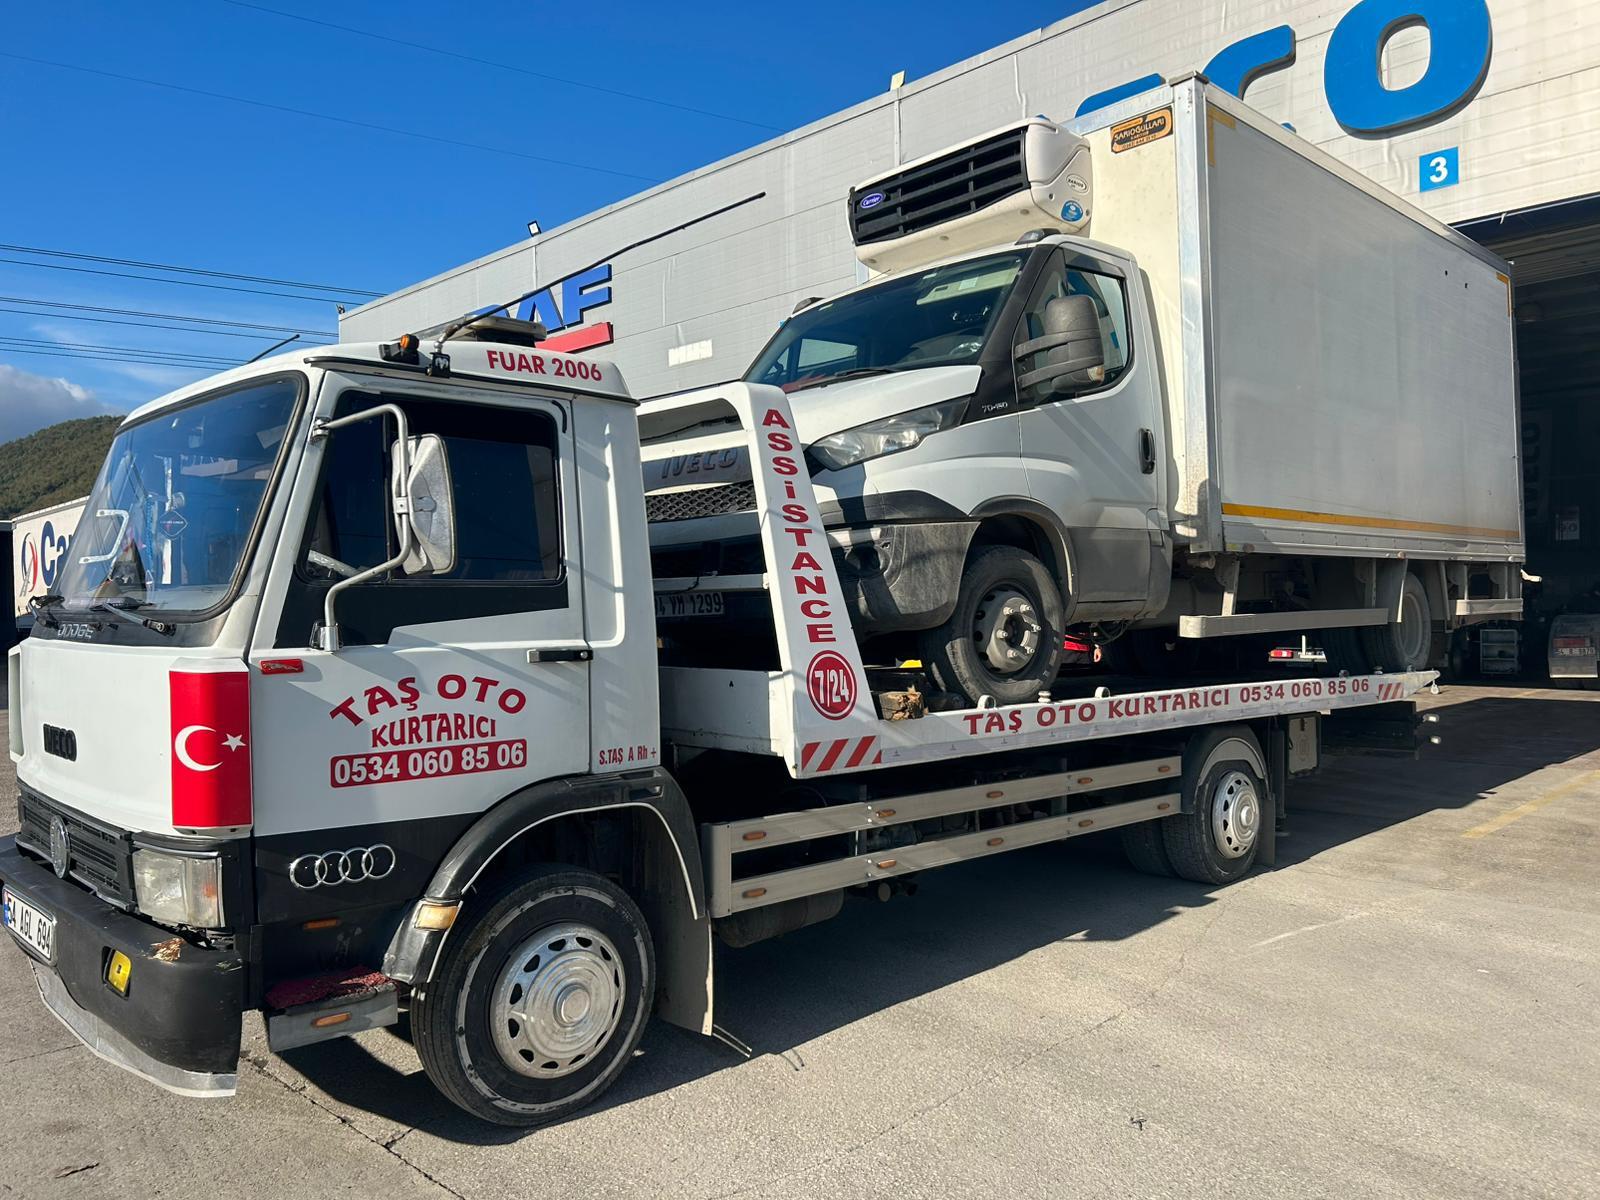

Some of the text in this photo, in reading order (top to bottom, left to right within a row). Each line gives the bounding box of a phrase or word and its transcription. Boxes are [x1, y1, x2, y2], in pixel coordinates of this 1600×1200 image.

[1430, 156, 1448, 184] 3
[486, 350, 602, 381] FUAR 2006
[661, 448, 738, 479] IVECO
[41, 520, 73, 587] Ca
[690, 592, 722, 614] 1299
[57, 623, 94, 640] DODGE
[329, 674, 527, 727] TAŞ OTO
[963, 709, 1022, 735] TAŞ
[1036, 702, 1097, 728] OTO
[1240, 684, 1285, 703] 0534
[1291, 681, 1322, 698] 060
[1328, 680, 1347, 696] 85
[1352, 678, 1369, 693] 06
[43, 723, 77, 762] IVECO
[371, 712, 497, 748] KURTARICI
[334, 741, 525, 785] 0534 060 85 06
[628, 746, 634, 762] A
[637, 745, 648, 761] Rh
[20, 906, 33, 941] AGL
[37, 918, 51, 955] 694
